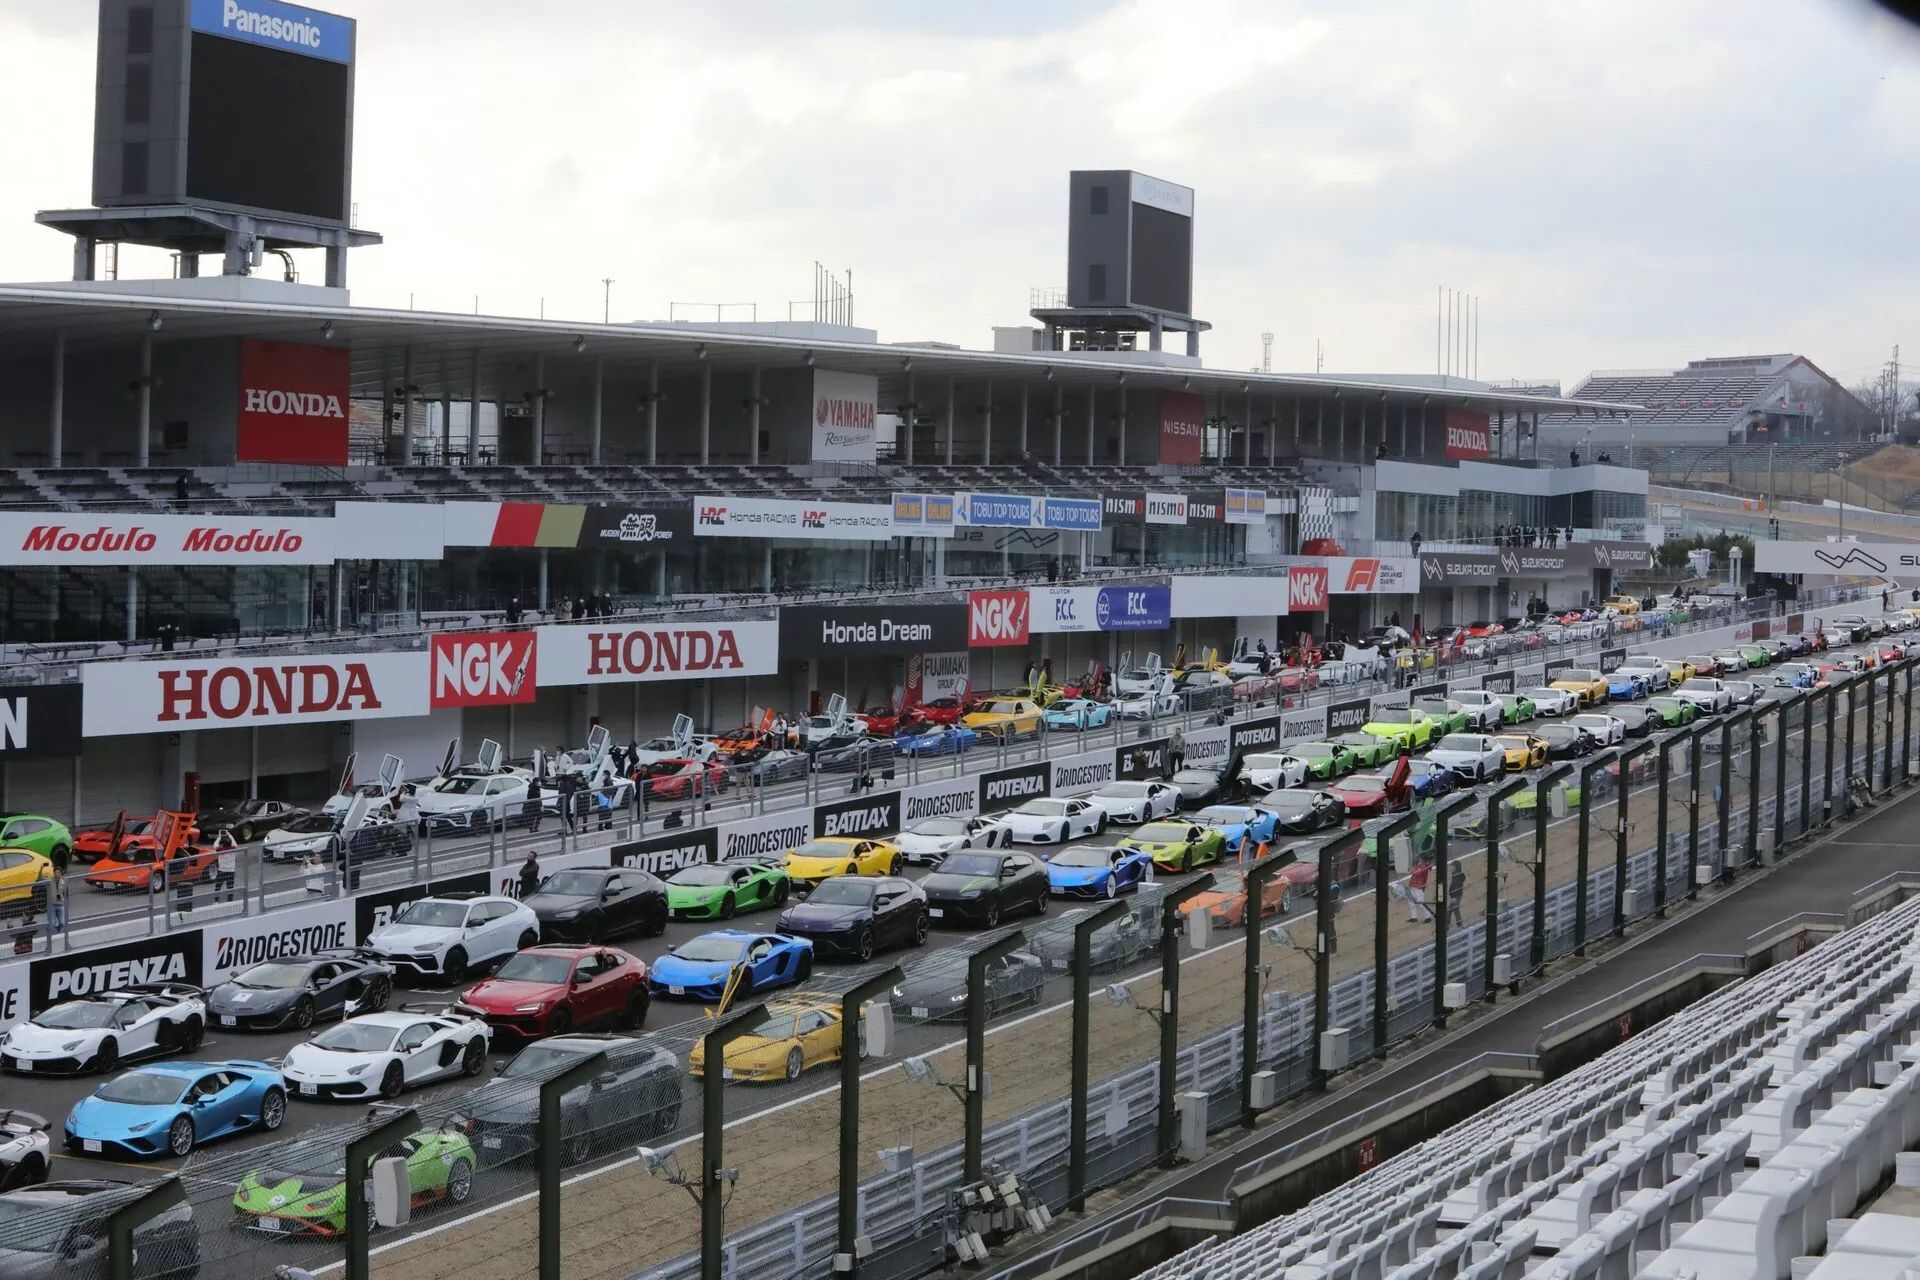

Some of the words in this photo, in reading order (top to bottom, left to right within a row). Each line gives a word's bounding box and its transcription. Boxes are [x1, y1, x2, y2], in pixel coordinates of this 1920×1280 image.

[223, 0, 320, 48] Panasonic
[245, 389, 344, 418] HONDA
[830, 399, 874, 430] YAMAHA
[1163, 420, 1199, 437] NISSAN
[1448, 427, 1488, 451] HONDA
[700, 507, 727, 525] HRC
[730, 512, 762, 523] Honda
[763, 513, 797, 524] RACING
[802, 511, 827, 528] HRC
[829, 516, 858, 527] Honda
[859, 517, 889, 527] RACING
[973, 502, 992, 518] TOBU
[994, 503, 1007, 518] TOP
[1008, 504, 1030, 520] TOURS
[1048, 506, 1065, 521] TOBU
[1066, 507, 1079, 522] TOP
[1079, 508, 1099, 523] TOURS
[22, 526, 157, 553] Modulo
[182, 528, 303, 553] Modulo
[600, 529, 620, 538] MUGEN
[654, 531, 673, 539] POWER
[1521, 558, 1544, 569] SUZUKA
[1544, 558, 1565, 569] CIRCUIT
[1611, 550, 1630, 560] SUZUKA
[1630, 550, 1647, 561] CIRCUIT
[1446, 564, 1472, 576] SUZUKA
[1473, 564, 1496, 576] CIRCUIT
[1291, 572, 1320, 606] NGK
[972, 597, 1016, 640] NGK
[823, 620, 877, 644] Honda
[881, 619, 932, 642] Dream
[587, 629, 744, 675] HONDA
[436, 640, 513, 698] NGK
[925, 655, 967, 676] FUJIMAKI
[157, 663, 382, 722] HONDA
[937, 679, 954, 690] GROUP
[1235, 727, 1276, 746] POTENZA
[1283, 719, 1324, 738] BRIDGESTONE
[1185, 740, 1227, 760] RIDGESTONE
[987, 776, 1044, 800] POTENZA
[1055, 763, 1112, 788] BRIDGESTONE
[907, 790, 974, 820] BRIDGESTONE
[824, 806, 891, 837] BATTLAX
[727, 825, 809, 858] BRIDGESTONE
[215, 921, 346, 970] BRIDGESTONE
[49, 952, 186, 1000] POTENZA
